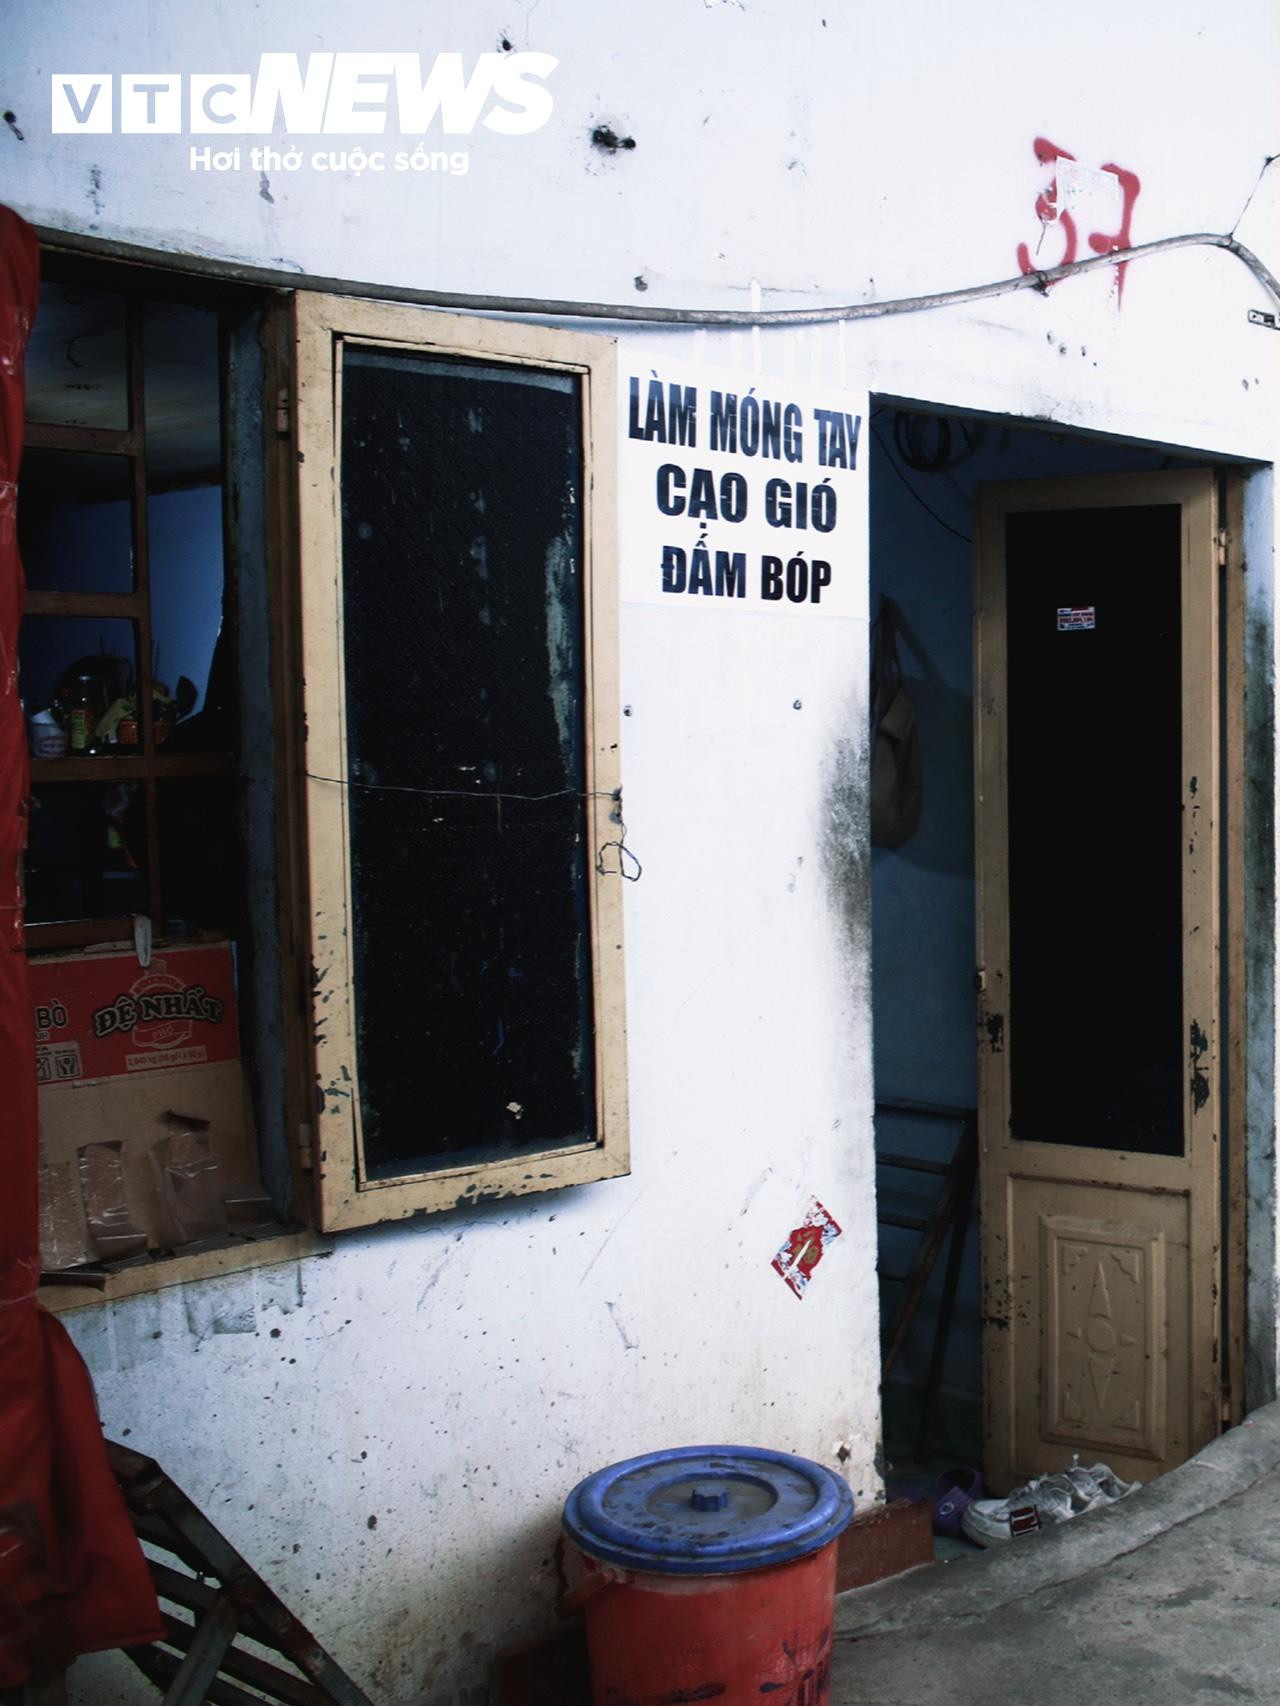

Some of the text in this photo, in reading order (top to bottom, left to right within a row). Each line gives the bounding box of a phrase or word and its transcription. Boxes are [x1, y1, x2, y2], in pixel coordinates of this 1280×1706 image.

[627, 369, 862, 471] LÀM MÓNG TAY
[656, 463, 837, 533] CẠO GIÓ
[661, 533, 832, 604] ĐẤM BÓP
[35, 998, 68, 1030] BÒ
[94, 987, 223, 1037] ĐỆ NHẤT
